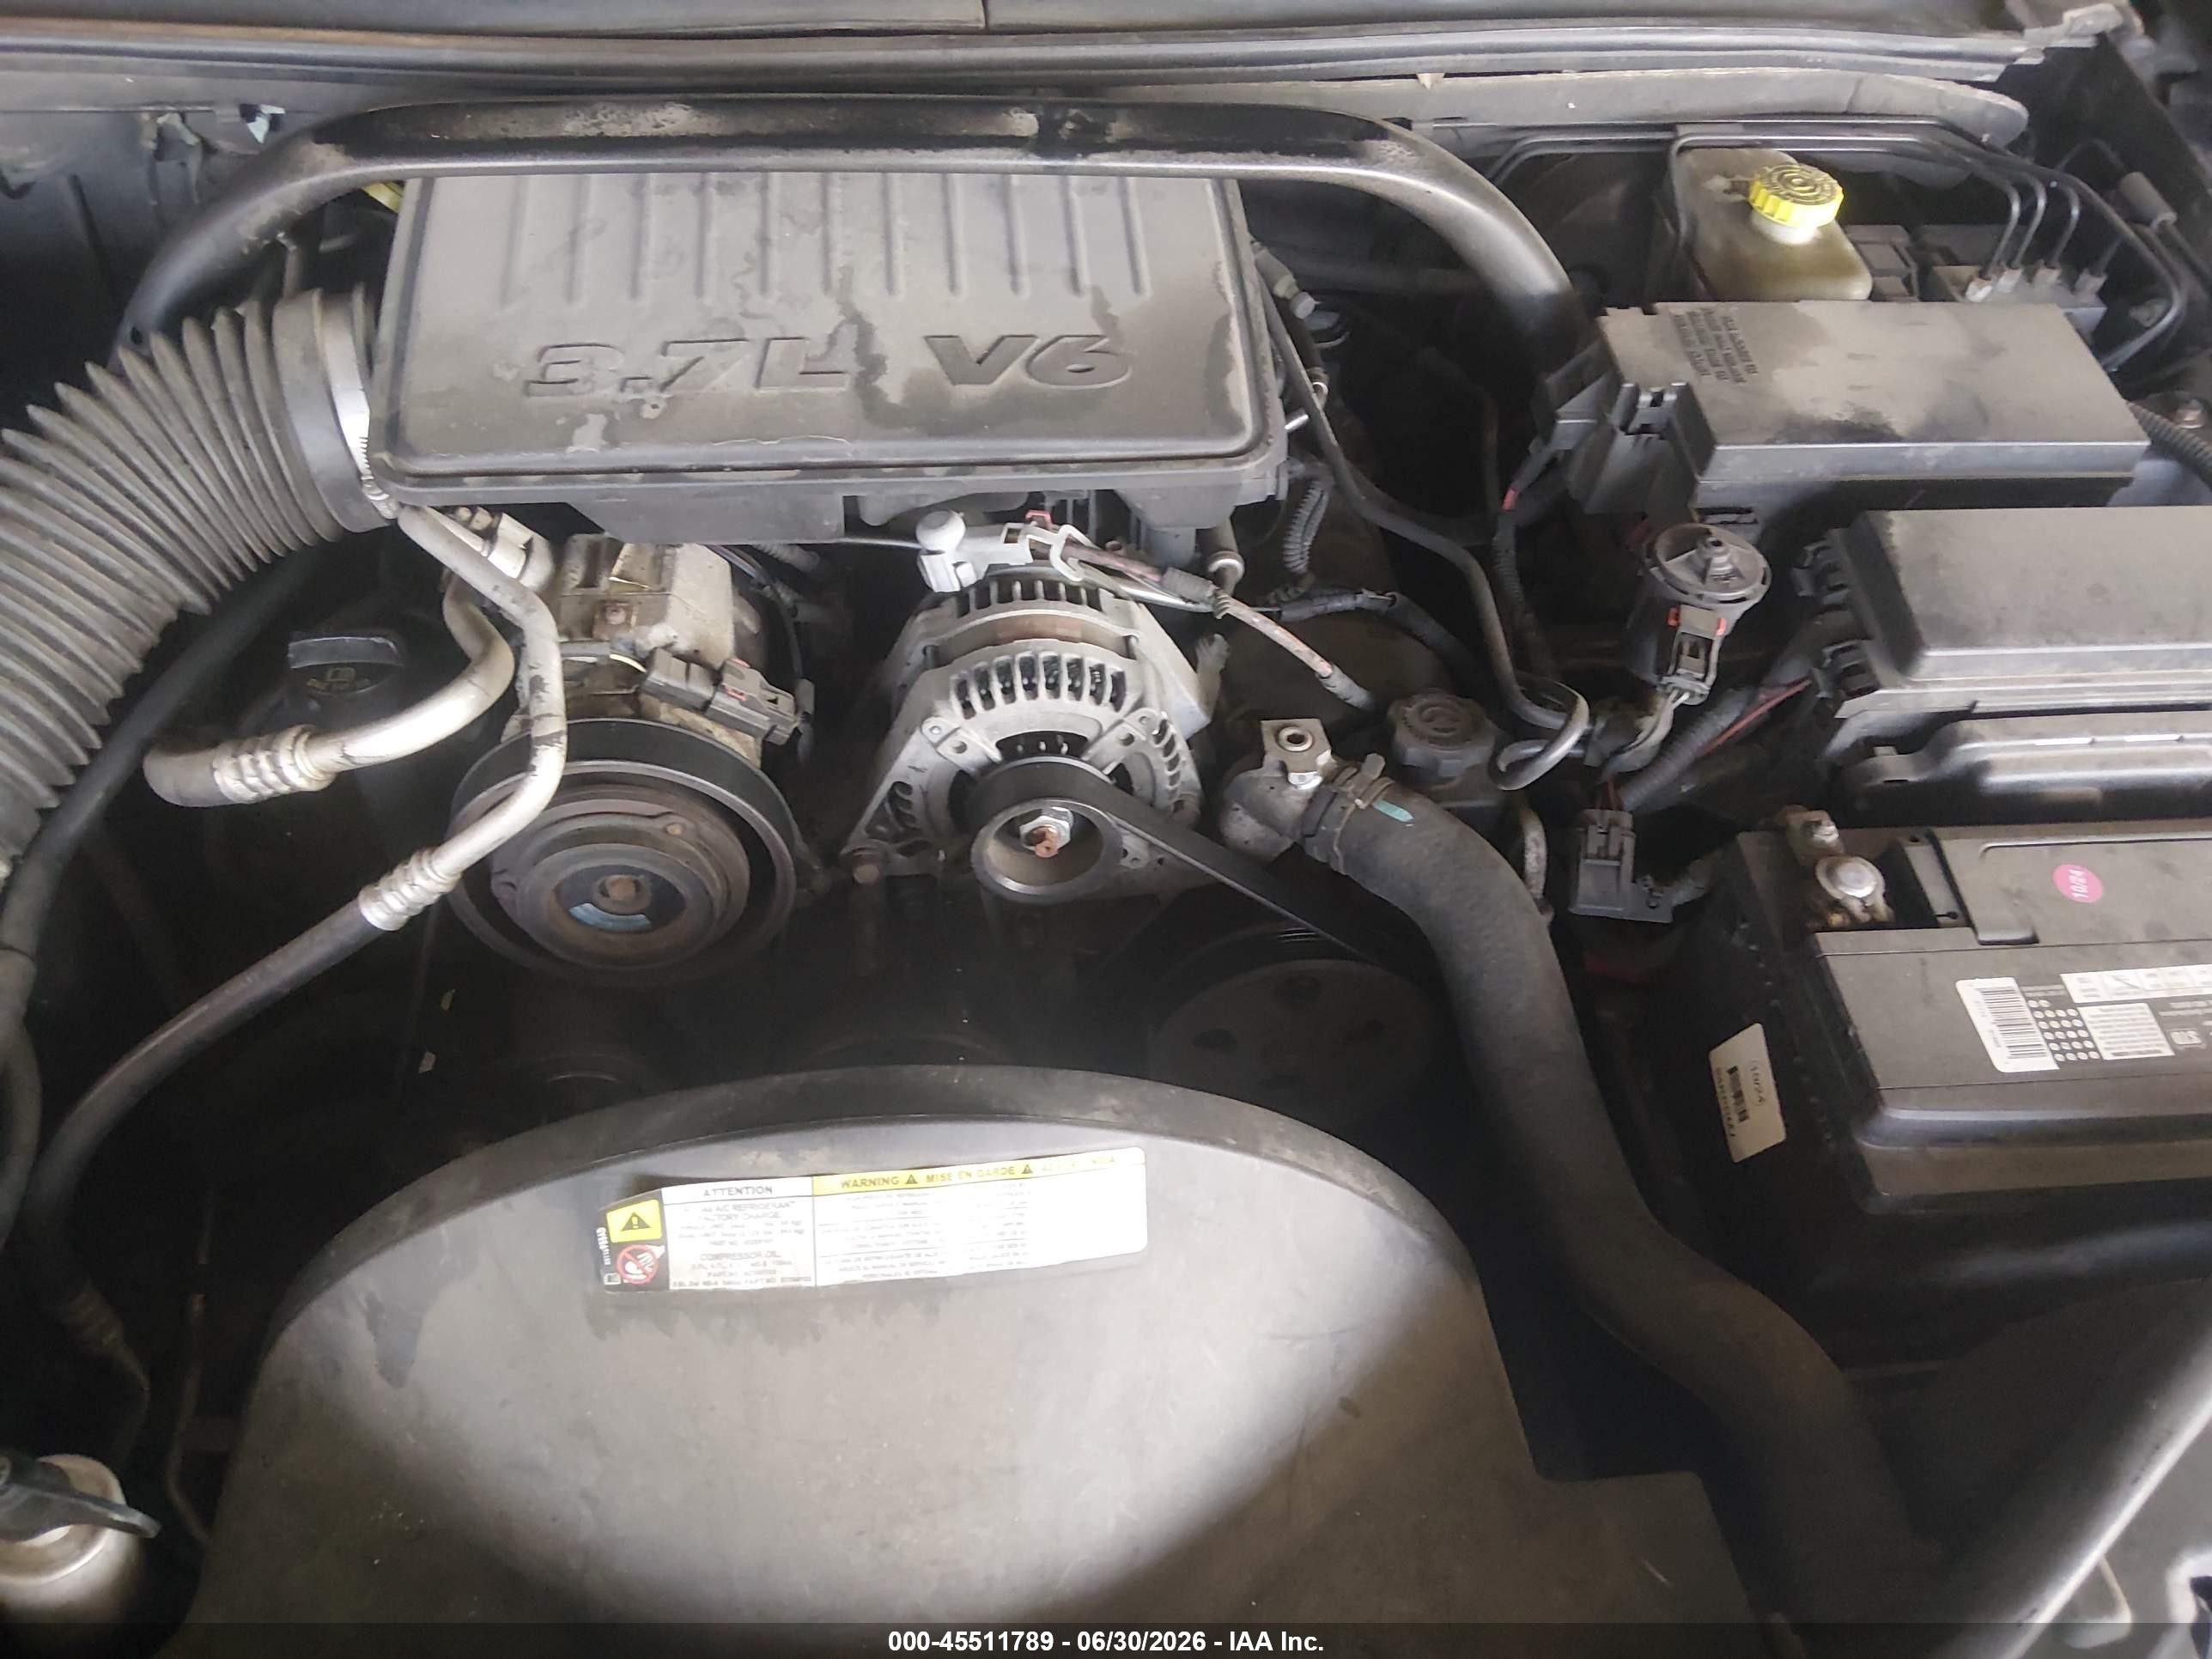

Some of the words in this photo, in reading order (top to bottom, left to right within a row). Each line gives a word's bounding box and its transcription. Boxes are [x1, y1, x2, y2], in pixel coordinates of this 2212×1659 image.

[525, 336, 848, 399] 3.7L
[923, 334, 1133, 390] V6
[2068, 869, 2090, 899] 10/24
[840, 1176, 900, 1188] WARNING
[926, 1171, 952, 1183] MISE
[958, 1170, 973, 1180] EN
[976, 1165, 1016, 1178] GARDE
[703, 1185, 774, 1197] ATTENTION
